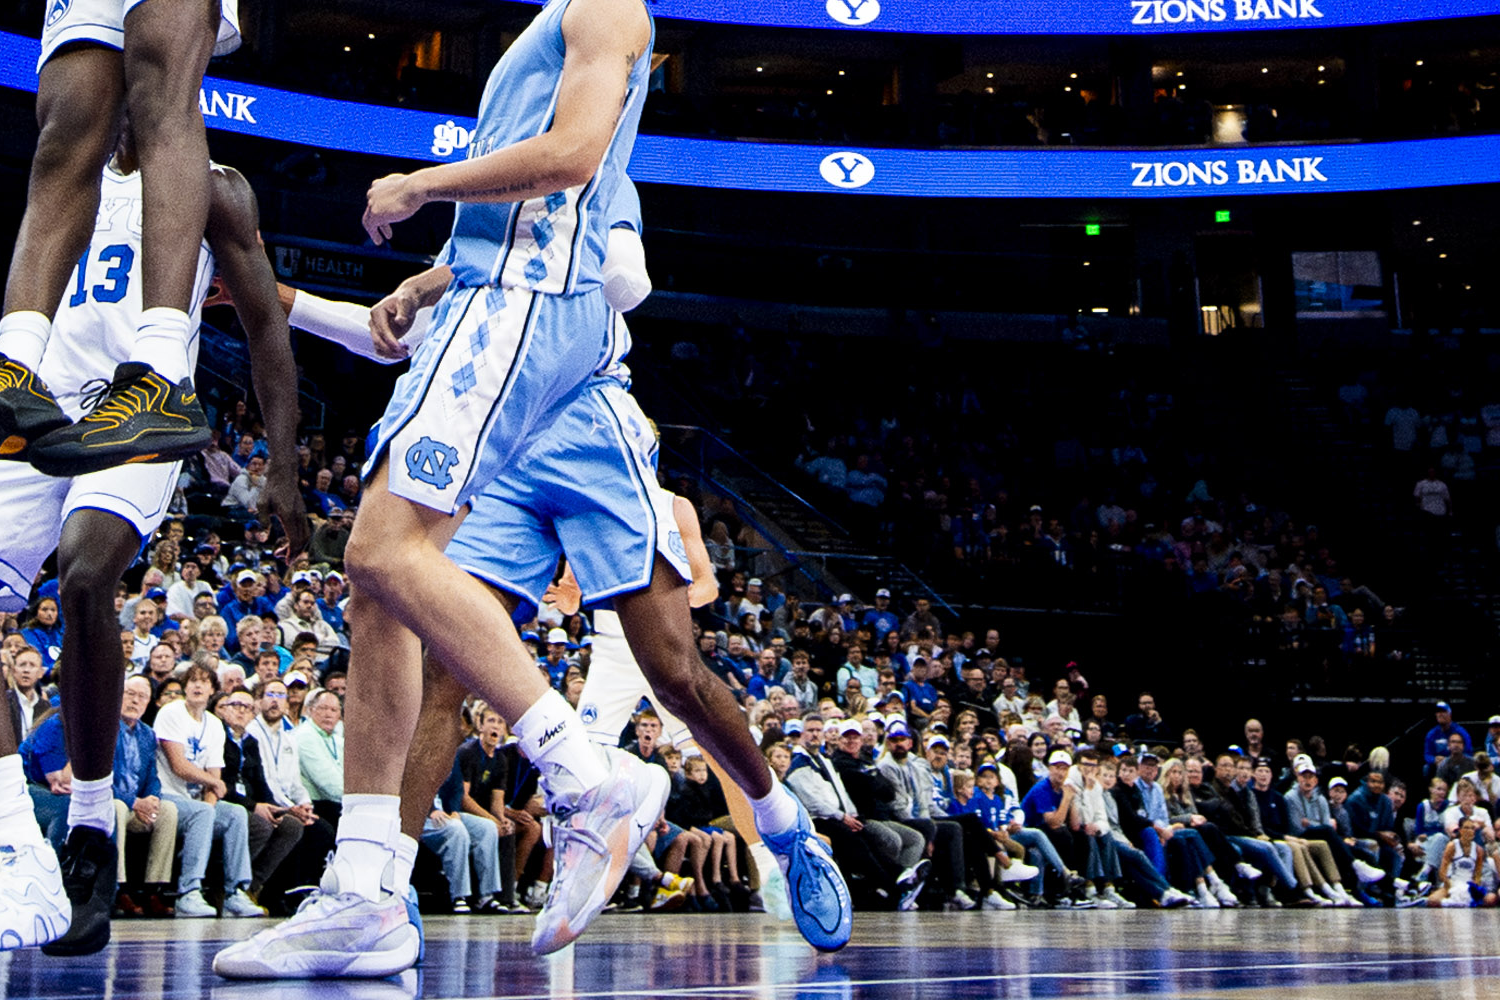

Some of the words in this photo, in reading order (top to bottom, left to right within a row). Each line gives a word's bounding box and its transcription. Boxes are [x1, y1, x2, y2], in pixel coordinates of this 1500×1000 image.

[1131, 161, 1229, 187] ZIONS
[1238, 157, 1328, 184] BANK
[69, 244, 135, 308] 13
[305, 255, 364, 278] HEALTH
